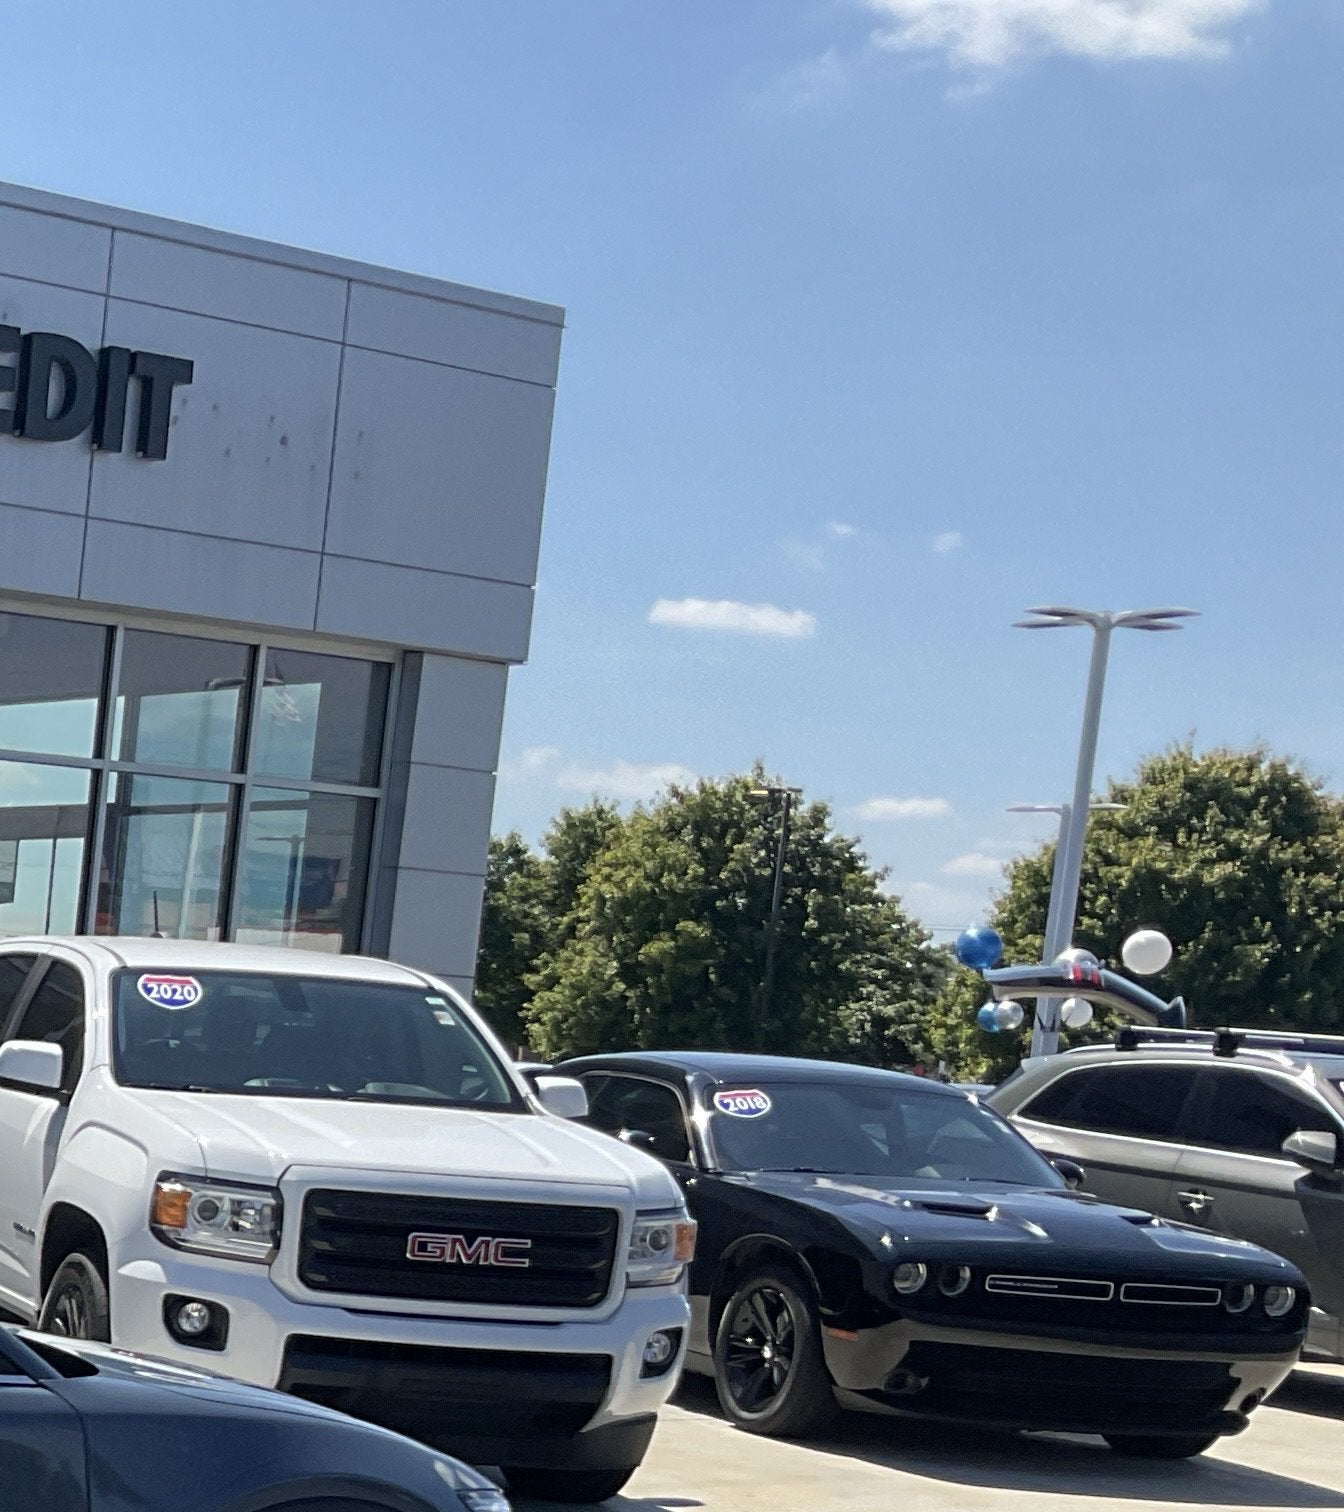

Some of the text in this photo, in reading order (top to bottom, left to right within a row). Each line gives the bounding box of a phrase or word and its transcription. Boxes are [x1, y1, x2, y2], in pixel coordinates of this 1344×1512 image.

[147, 983, 196, 1001] 2020
[723, 1096, 767, 1111] 2018
[406, 1232, 531, 1267] GMC
